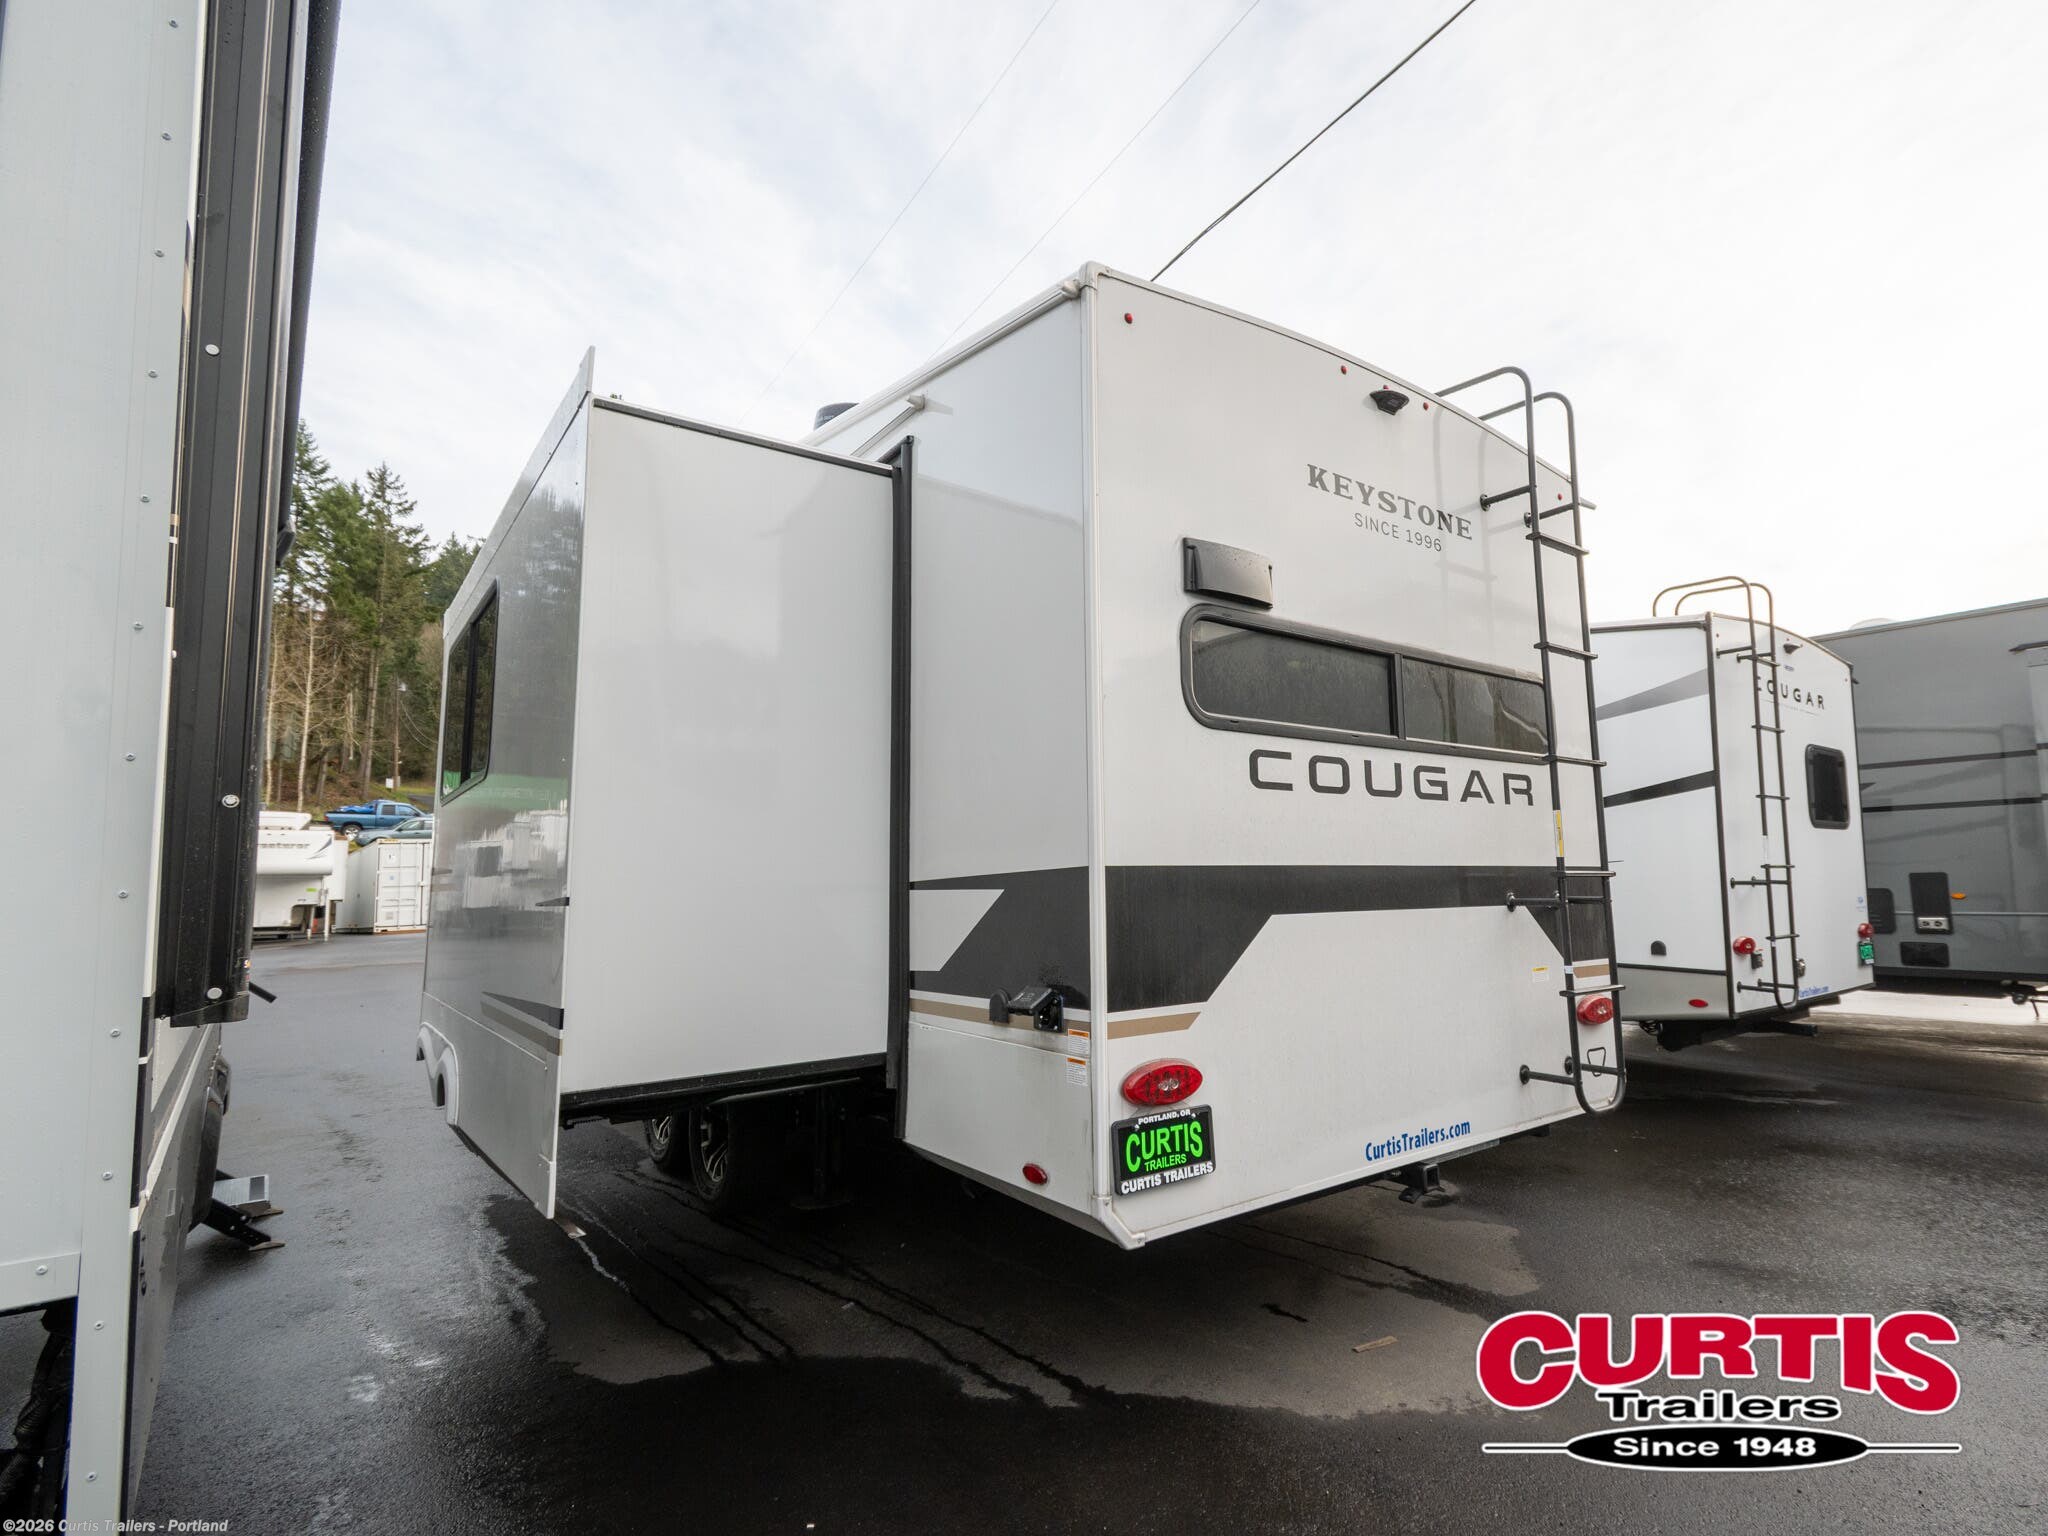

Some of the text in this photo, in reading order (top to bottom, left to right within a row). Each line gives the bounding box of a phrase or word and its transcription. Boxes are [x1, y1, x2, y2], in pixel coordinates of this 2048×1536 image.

[1307, 464, 1473, 540] KEYSTONE
[1354, 512, 1442, 552] SINCE 1996
[1757, 676, 1824, 710] OUGAR
[1249, 749, 1534, 806] COUGAR
[1126, 1120, 1203, 1172] CURTIS
[1365, 1120, 1471, 1161] CurtisTrailers.com
[1121, 1161, 1213, 1194] CURTIS TRAILERS
[1144, 1154, 1187, 1172] TRAILERS
